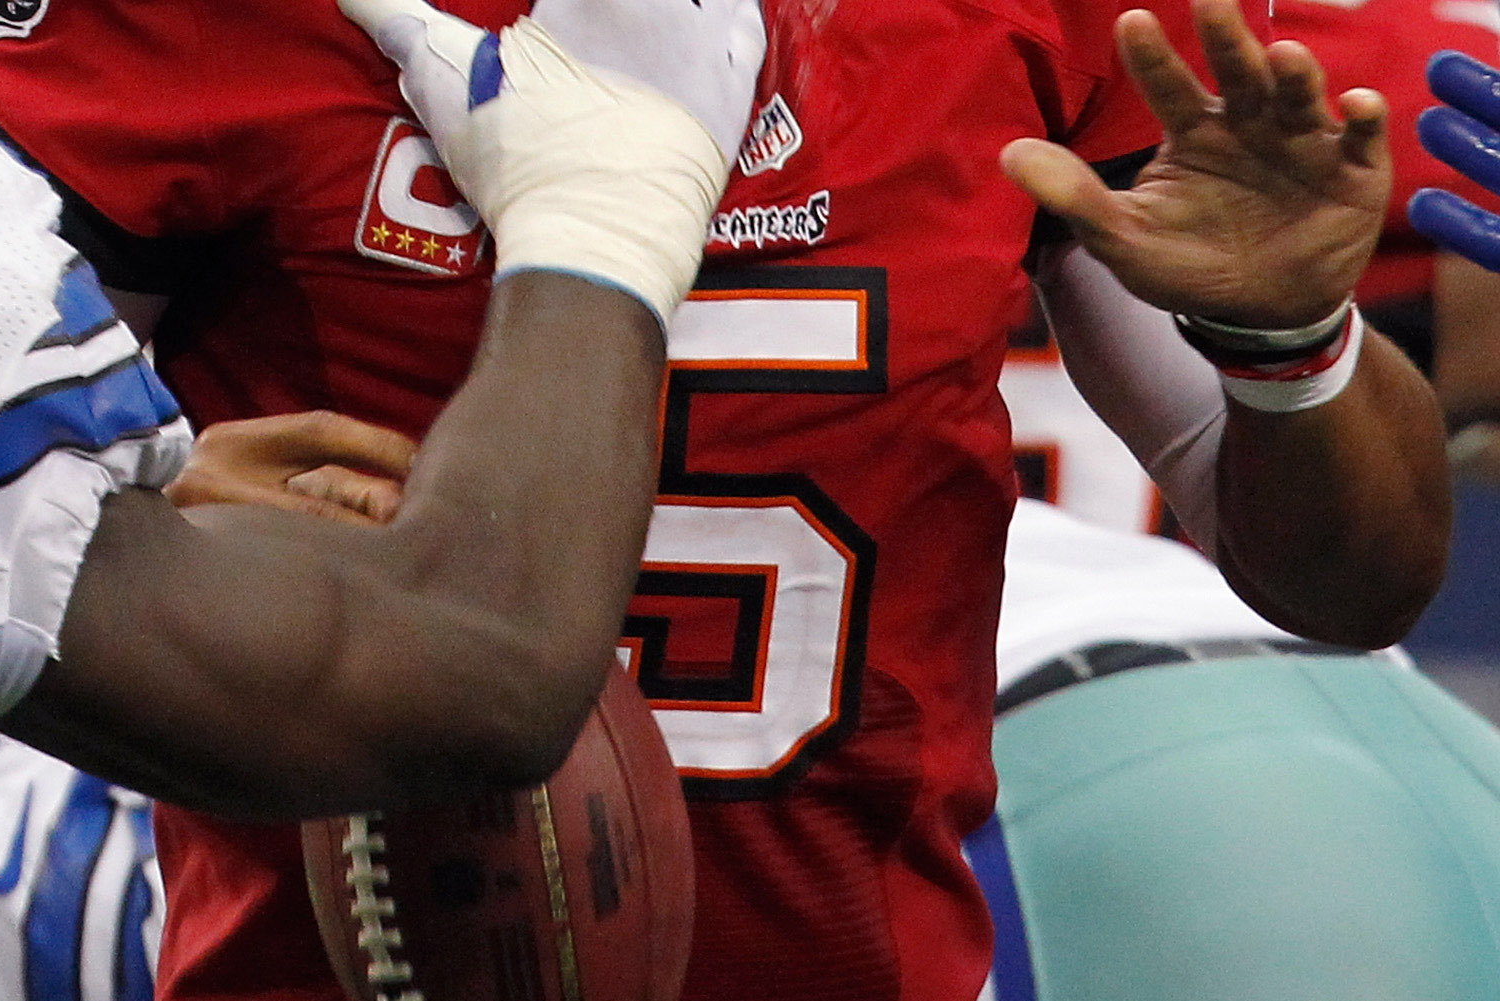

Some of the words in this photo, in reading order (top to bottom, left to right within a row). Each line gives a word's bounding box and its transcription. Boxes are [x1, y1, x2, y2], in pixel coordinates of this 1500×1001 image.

[748, 119, 793, 168] NFL
[378, 136, 480, 237] C
[709, 190, 830, 250] CANEERS
[620, 266, 889, 798] 5
